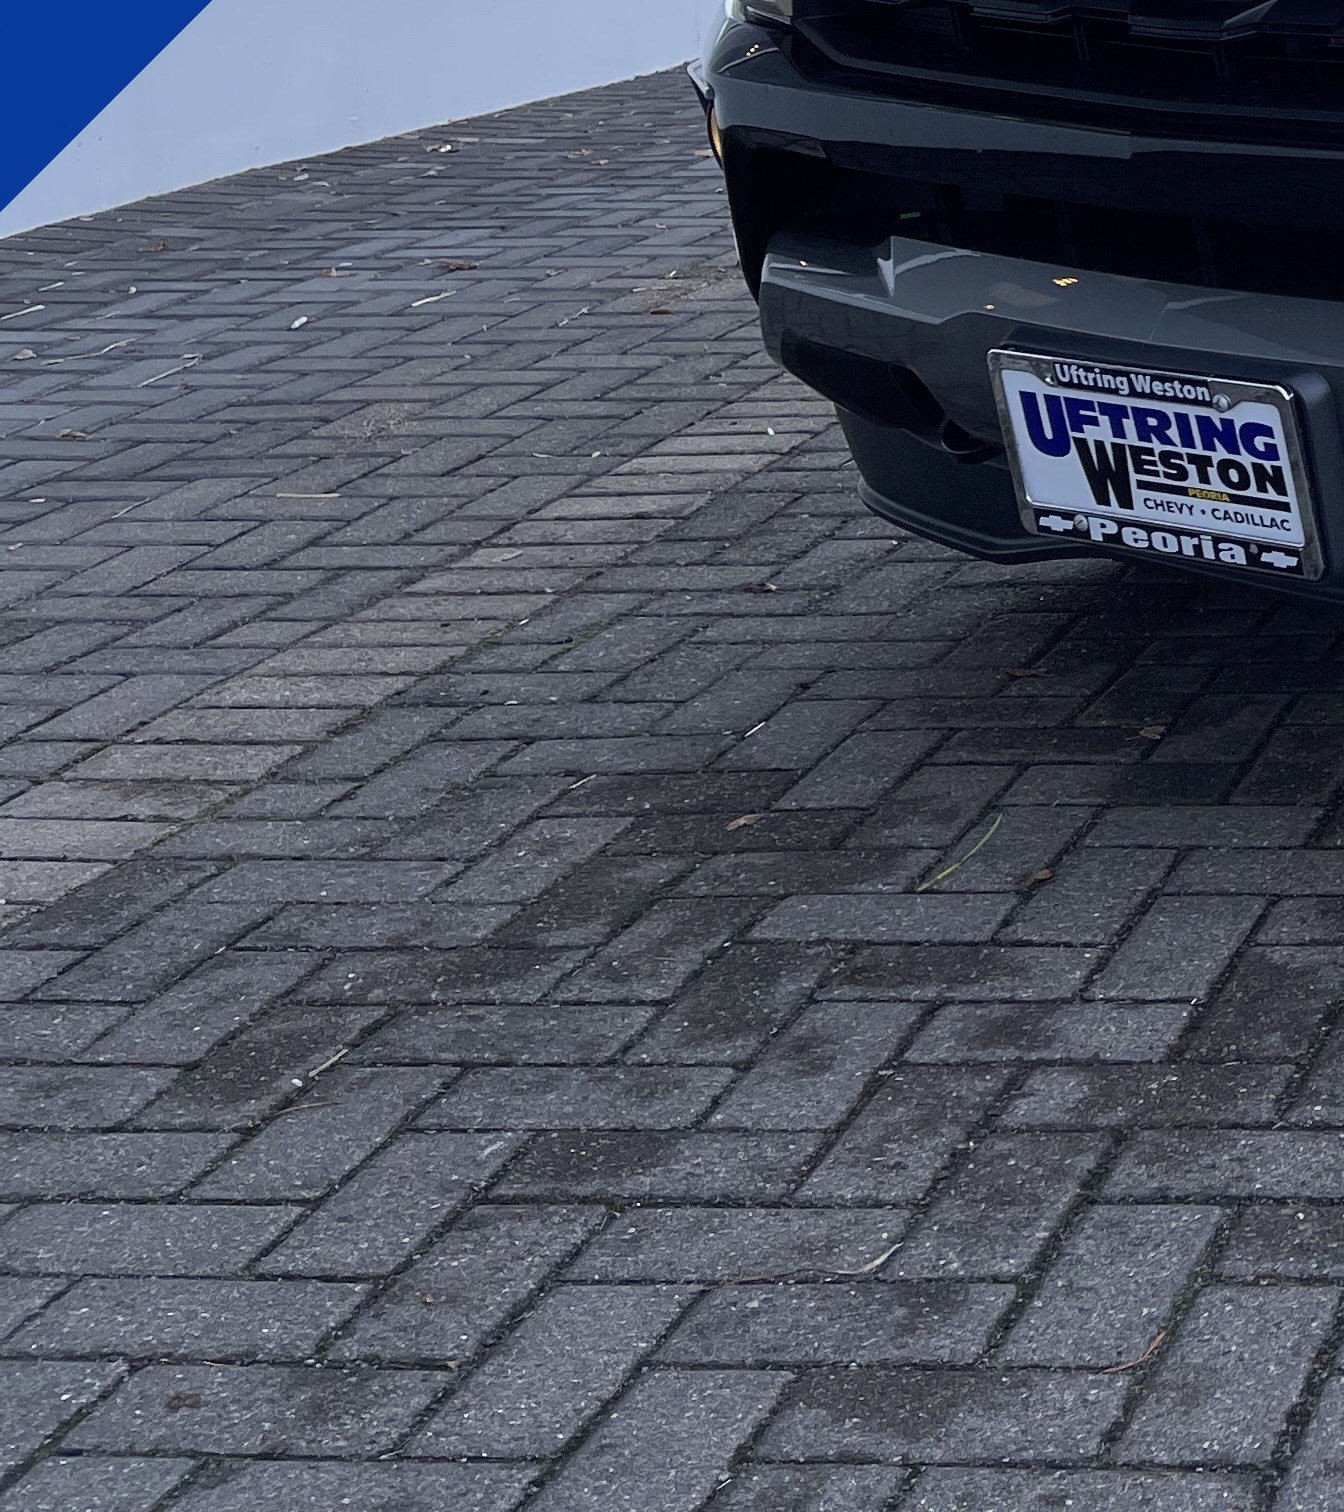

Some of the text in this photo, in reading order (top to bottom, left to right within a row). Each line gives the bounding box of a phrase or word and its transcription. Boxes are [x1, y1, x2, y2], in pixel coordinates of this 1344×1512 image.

[1054, 363, 1212, 403] Uftring Weston
[1018, 390, 1281, 462] UFTRING
[1071, 436, 1289, 511] WESTON
[1187, 488, 1231, 502] PEORIA
[1142, 497, 1291, 533] CHEVY CADILLAC
[1088, 516, 1248, 566] Peoria
